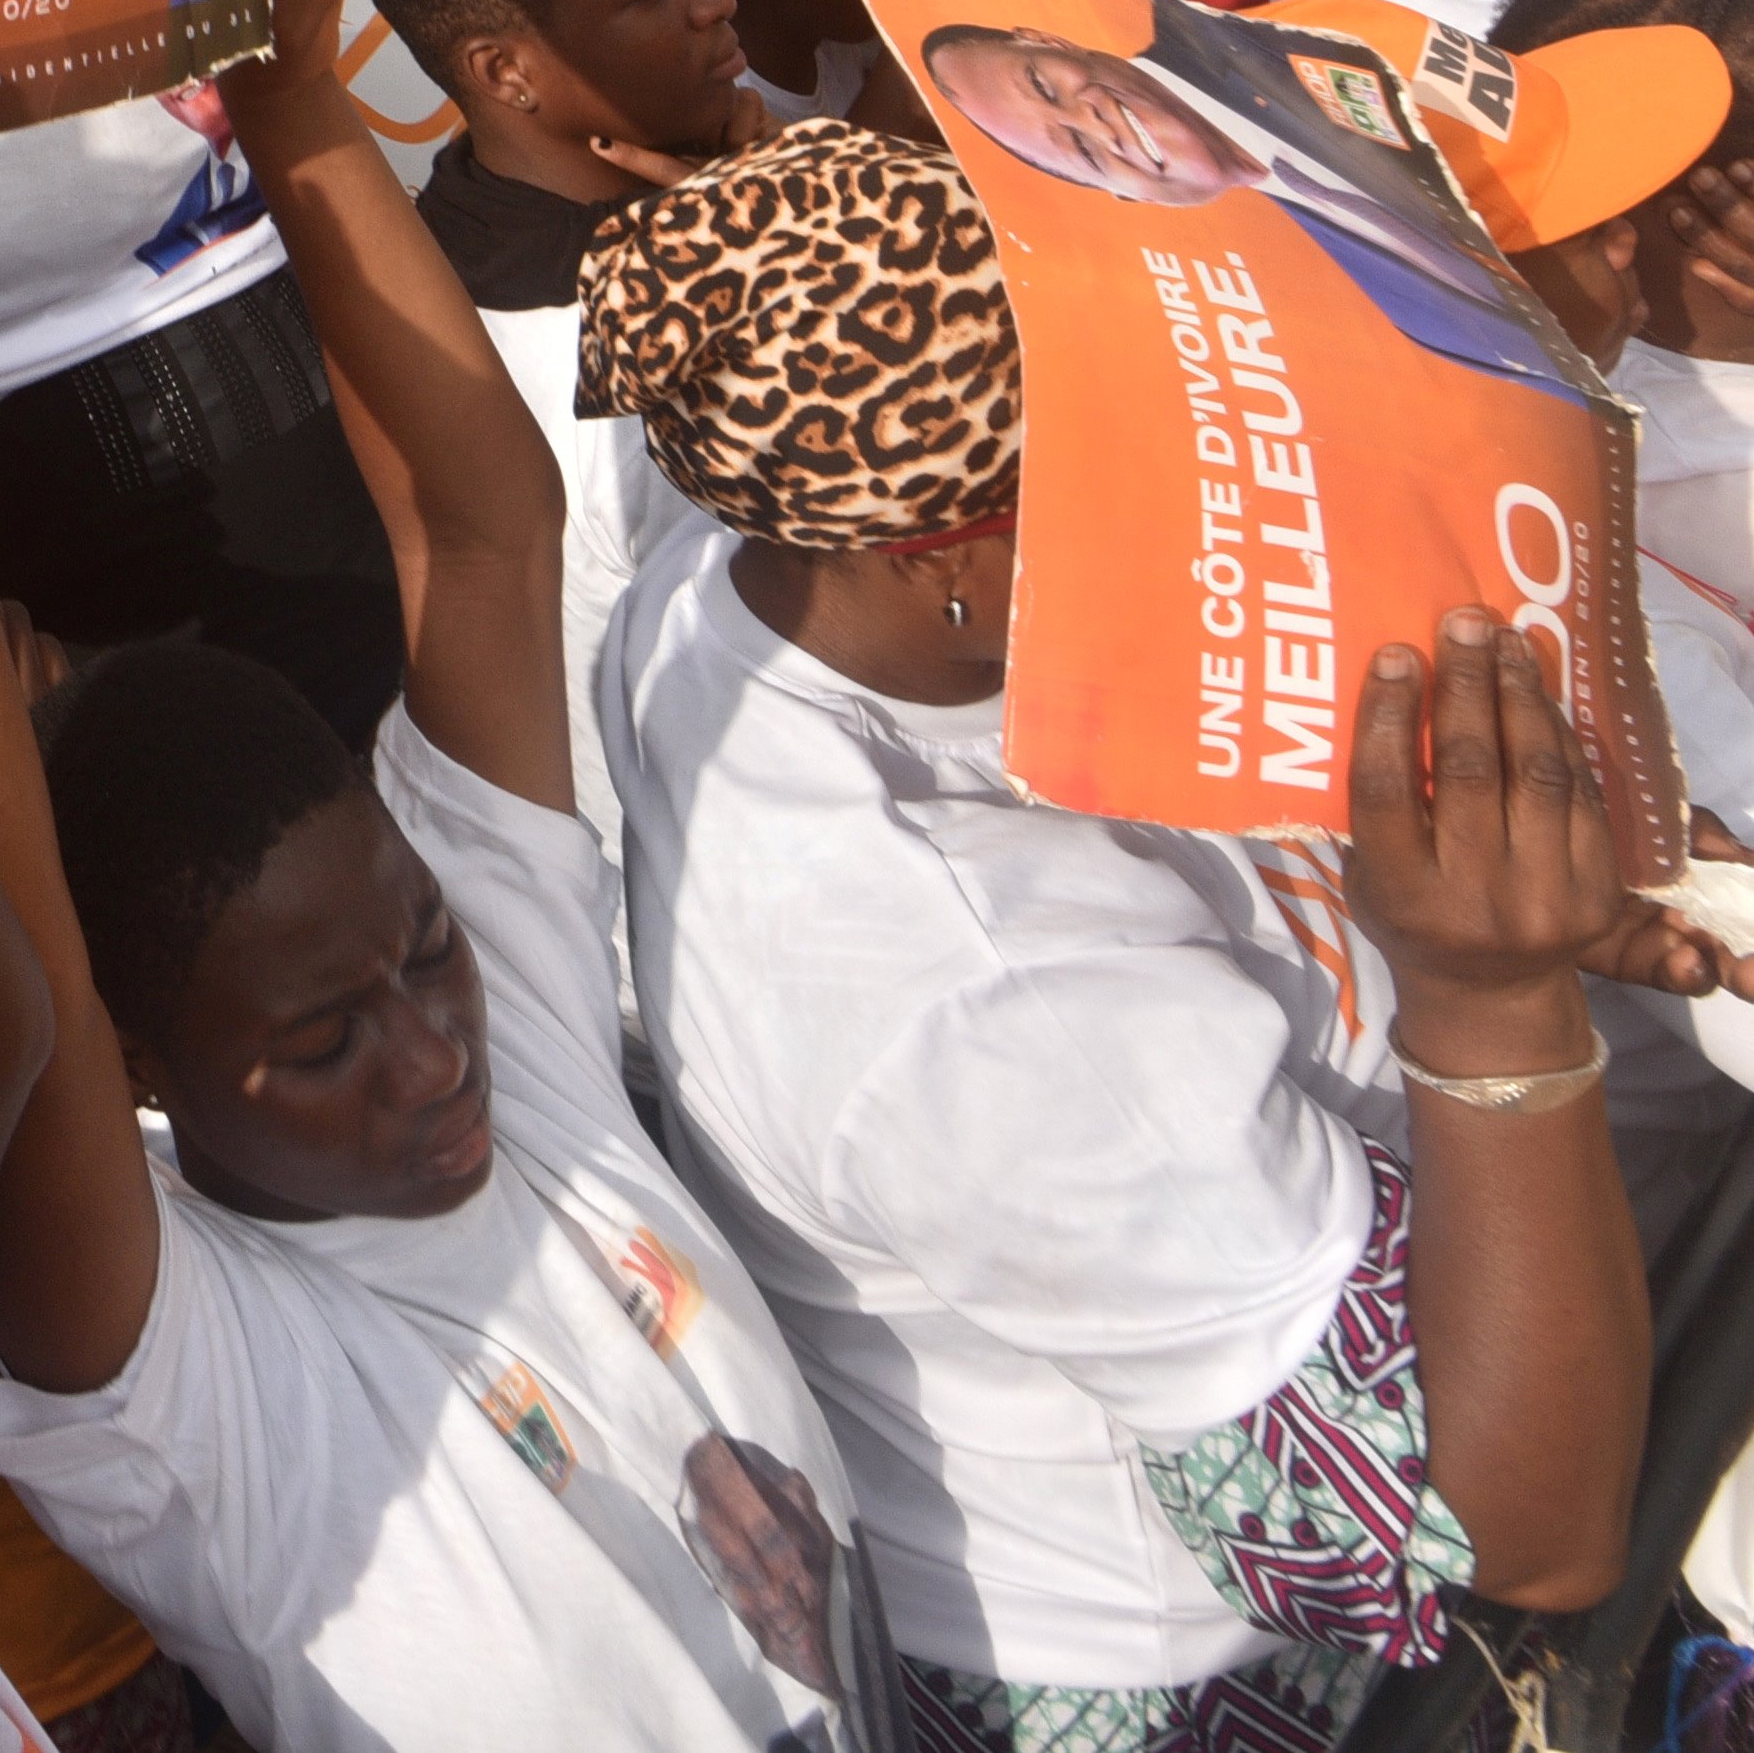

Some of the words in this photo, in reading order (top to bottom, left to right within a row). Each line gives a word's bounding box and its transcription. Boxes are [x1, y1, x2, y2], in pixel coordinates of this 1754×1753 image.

[1141, 246, 1239, 467] D'IVOIRE
[1191, 250, 1336, 791] MEILLEURE.
[1192, 479, 1245, 639] CÔTE
[1495, 482, 1576, 728] DO
[1196, 651, 1245, 779] UNE
